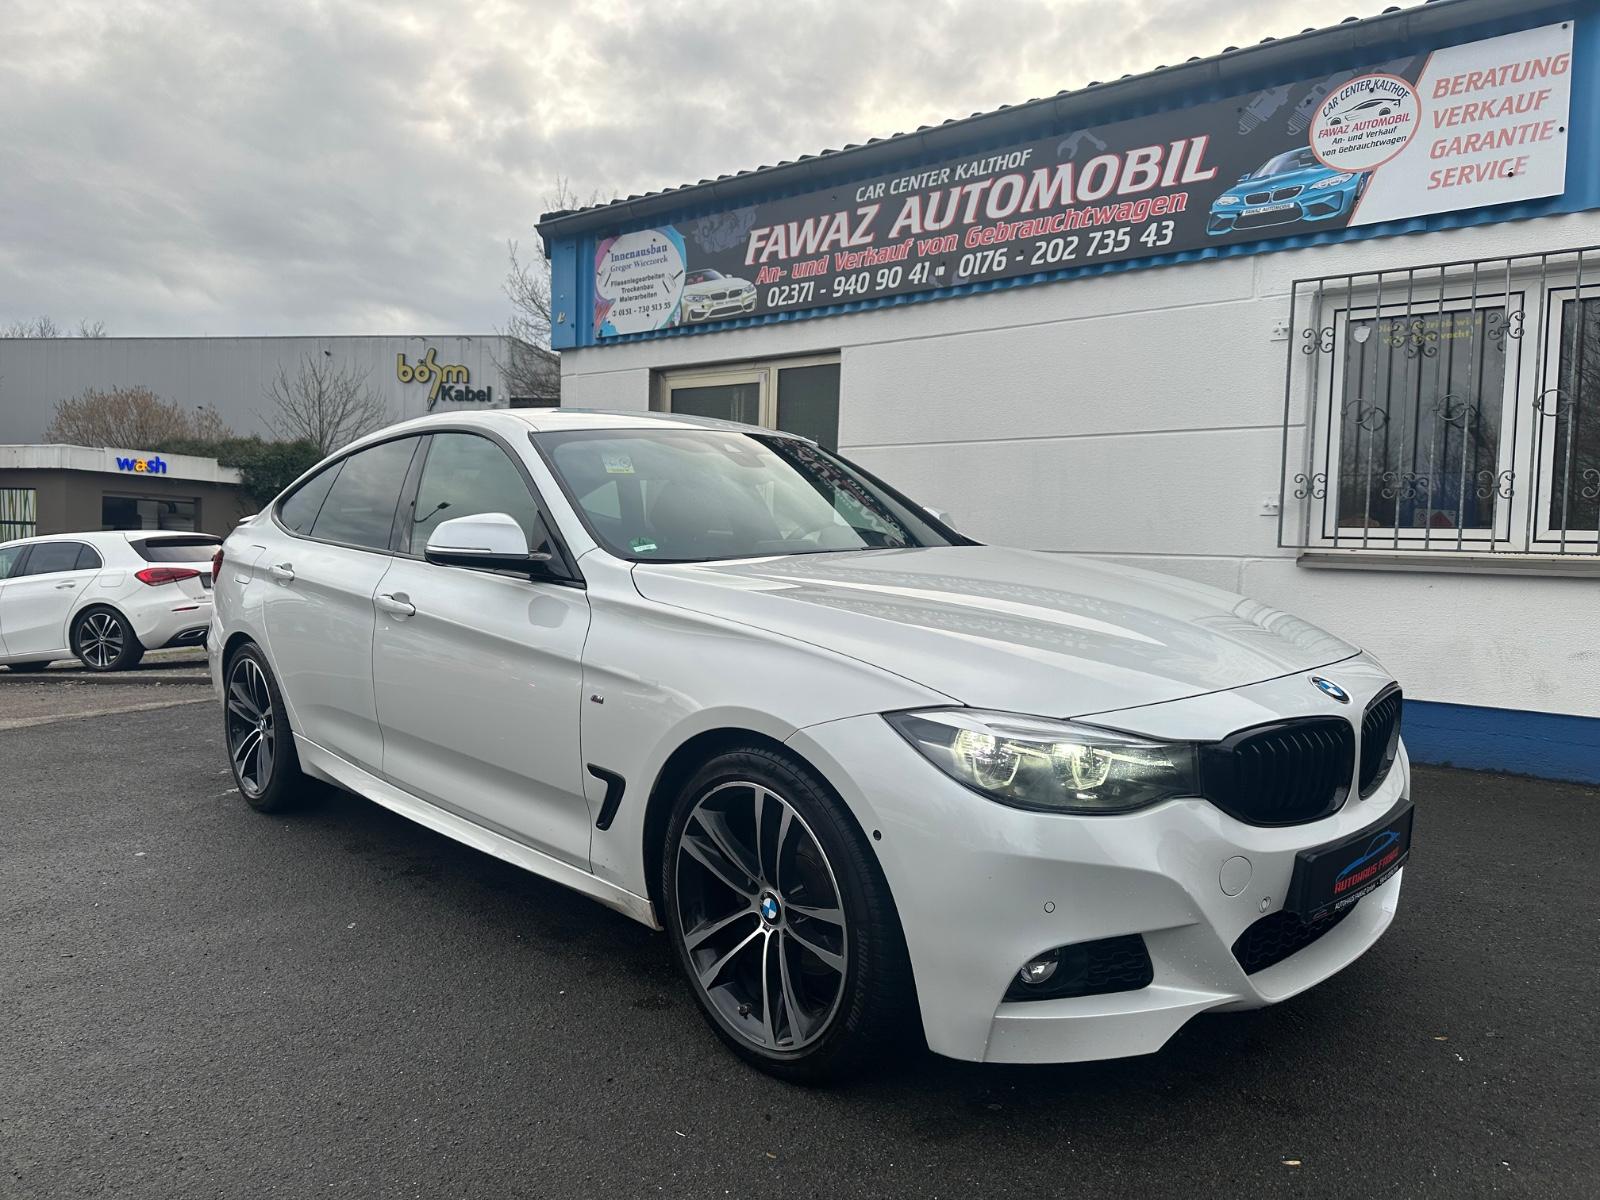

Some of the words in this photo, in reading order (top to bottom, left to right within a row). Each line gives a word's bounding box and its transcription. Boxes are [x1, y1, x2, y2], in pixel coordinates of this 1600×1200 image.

[1432, 53, 1570, 99] BERATUNG
[1322, 97, 1339, 117] CAR
[1340, 80, 1373, 101] CENTER
[1373, 79, 1411, 99] KALTHOF
[1433, 88, 1552, 129] VERKAUF
[1318, 125, 1350, 139] FAWAZ
[1352, 113, 1411, 132] AUTOMOBIL
[1332, 136, 1345, 145] An-
[1347, 132, 1363, 142] und
[1366, 126, 1398, 138] Verkauf
[1430, 119, 1556, 160] GARANTIE
[1322, 149, 1337, 157] von
[1338, 136, 1407, 154] Gebrauchtwagen
[856, 183, 884, 202] CAR
[890, 168, 950, 194] CENTER
[955, 149, 1032, 181] KALTHOF
[1427, 155, 1530, 190] SERVICE
[745, 203, 881, 266] FAWAZ
[888, 134, 1218, 239] AUTOMOBIL
[611, 244, 667, 262] Innenausbau
[755, 266, 787, 285] An-
[791, 254, 829, 280] und
[834, 238, 914, 272] Verkauf
[917, 233, 958, 257] von
[965, 192, 1188, 248] Gebrauchtwagen
[610, 264, 632, 273] Gregor
[767, 281, 814, 308] 02371
[833, 272, 870, 298] 940
[875, 266, 903, 291] 90
[908, 261, 930, 285] 41
[958, 248, 1008, 278] 0176
[1031, 235, 1080, 266] 202
[1086, 226, 1131, 257] 735
[1139, 220, 1175, 248] 43
[620, 292, 657, 302] Malerarbeiten
[621, 284, 654, 294] Trockenbau
[441, 385, 492, 402] Kabel
[116, 456, 167, 474] wash
